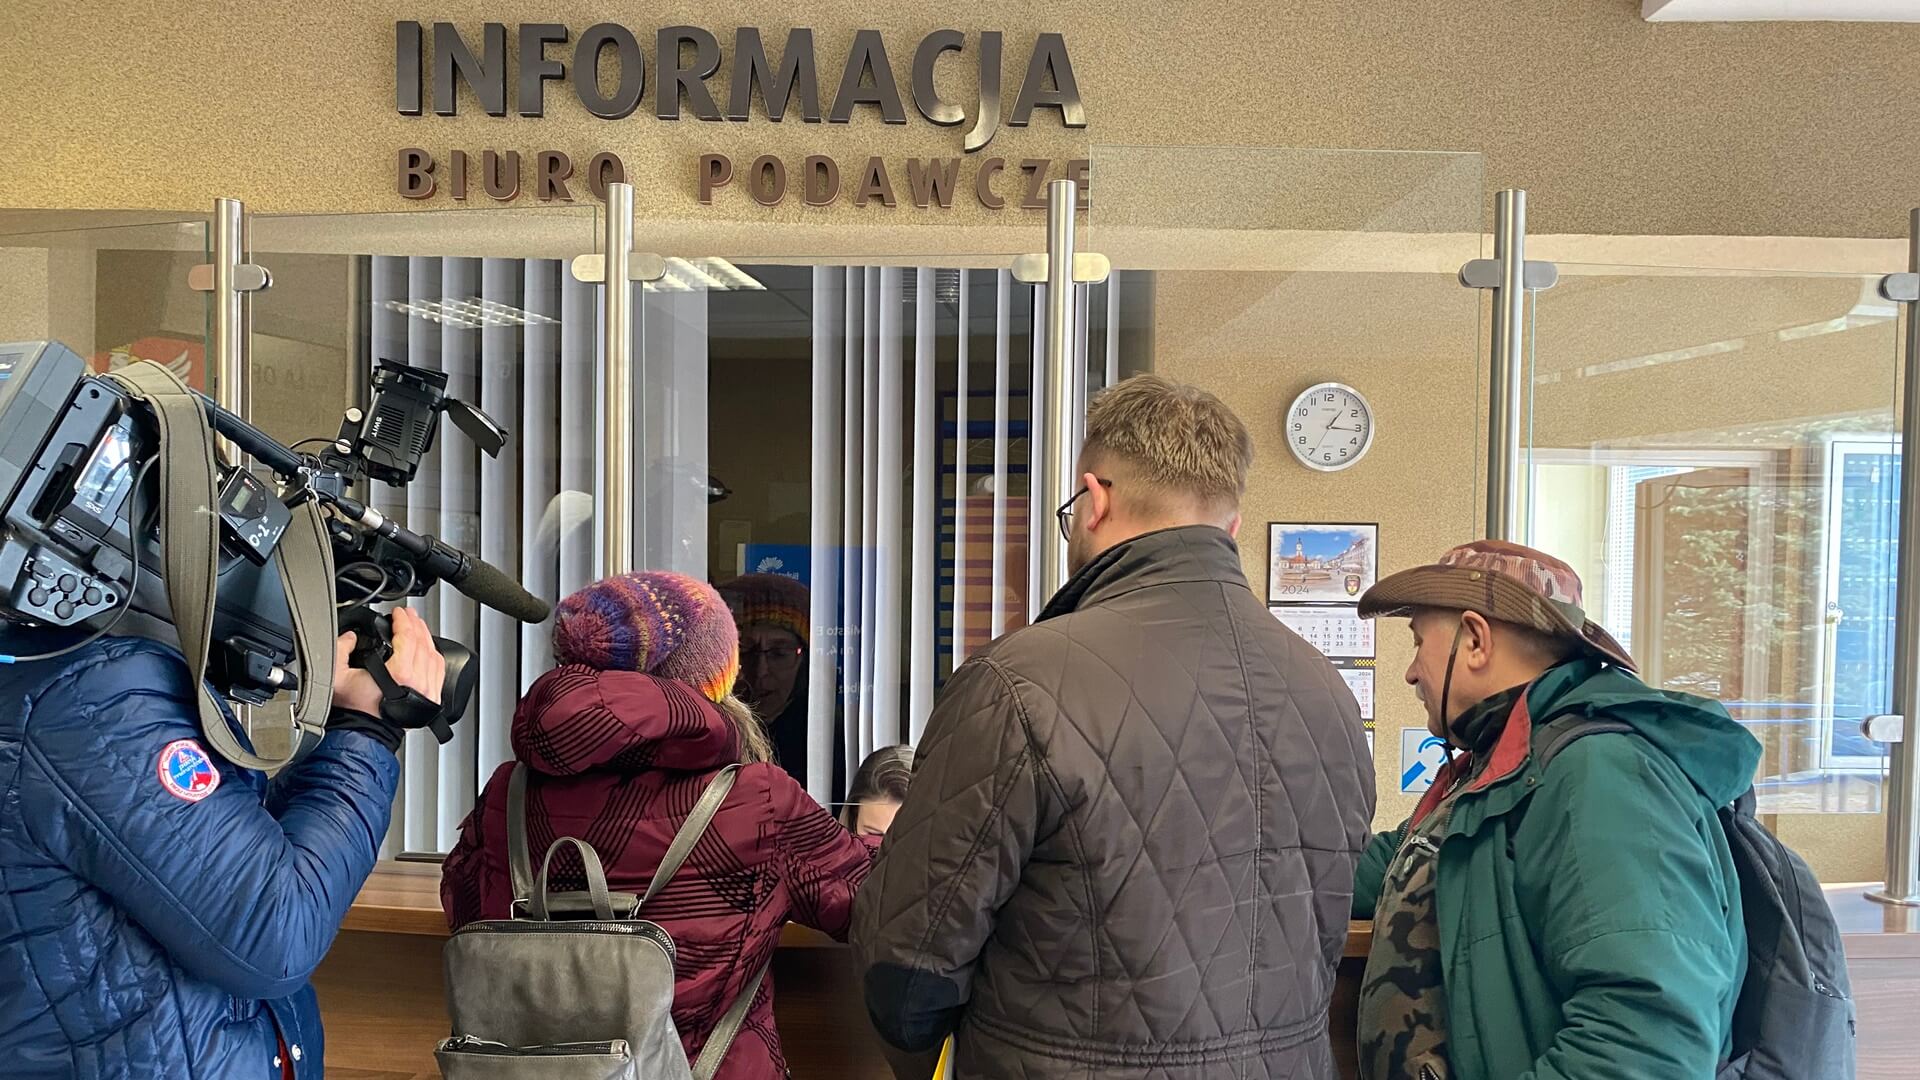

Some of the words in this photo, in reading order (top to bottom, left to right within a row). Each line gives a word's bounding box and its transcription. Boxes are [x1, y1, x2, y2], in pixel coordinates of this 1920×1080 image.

[396, 20, 1087, 152] INFORMACJA
[397, 148, 625, 202] BIURO
[1310, 397, 1316, 406] 11
[1324, 394, 1335, 402] 12
[1298, 408, 1308, 417] 10
[1350, 409, 1359, 418] 2
[371, 416, 383, 438] SWIT
[1294, 423, 1302, 431] 9
[1355, 424, 1362, 432] 3
[1298, 436, 1307, 444] 8
[1349, 437, 1357, 445] 4
[1308, 448, 1316, 456] 7
[1323, 452, 1331, 461] 6
[1339, 448, 1347, 457] 5
[1281, 584, 1310, 595] 2024
